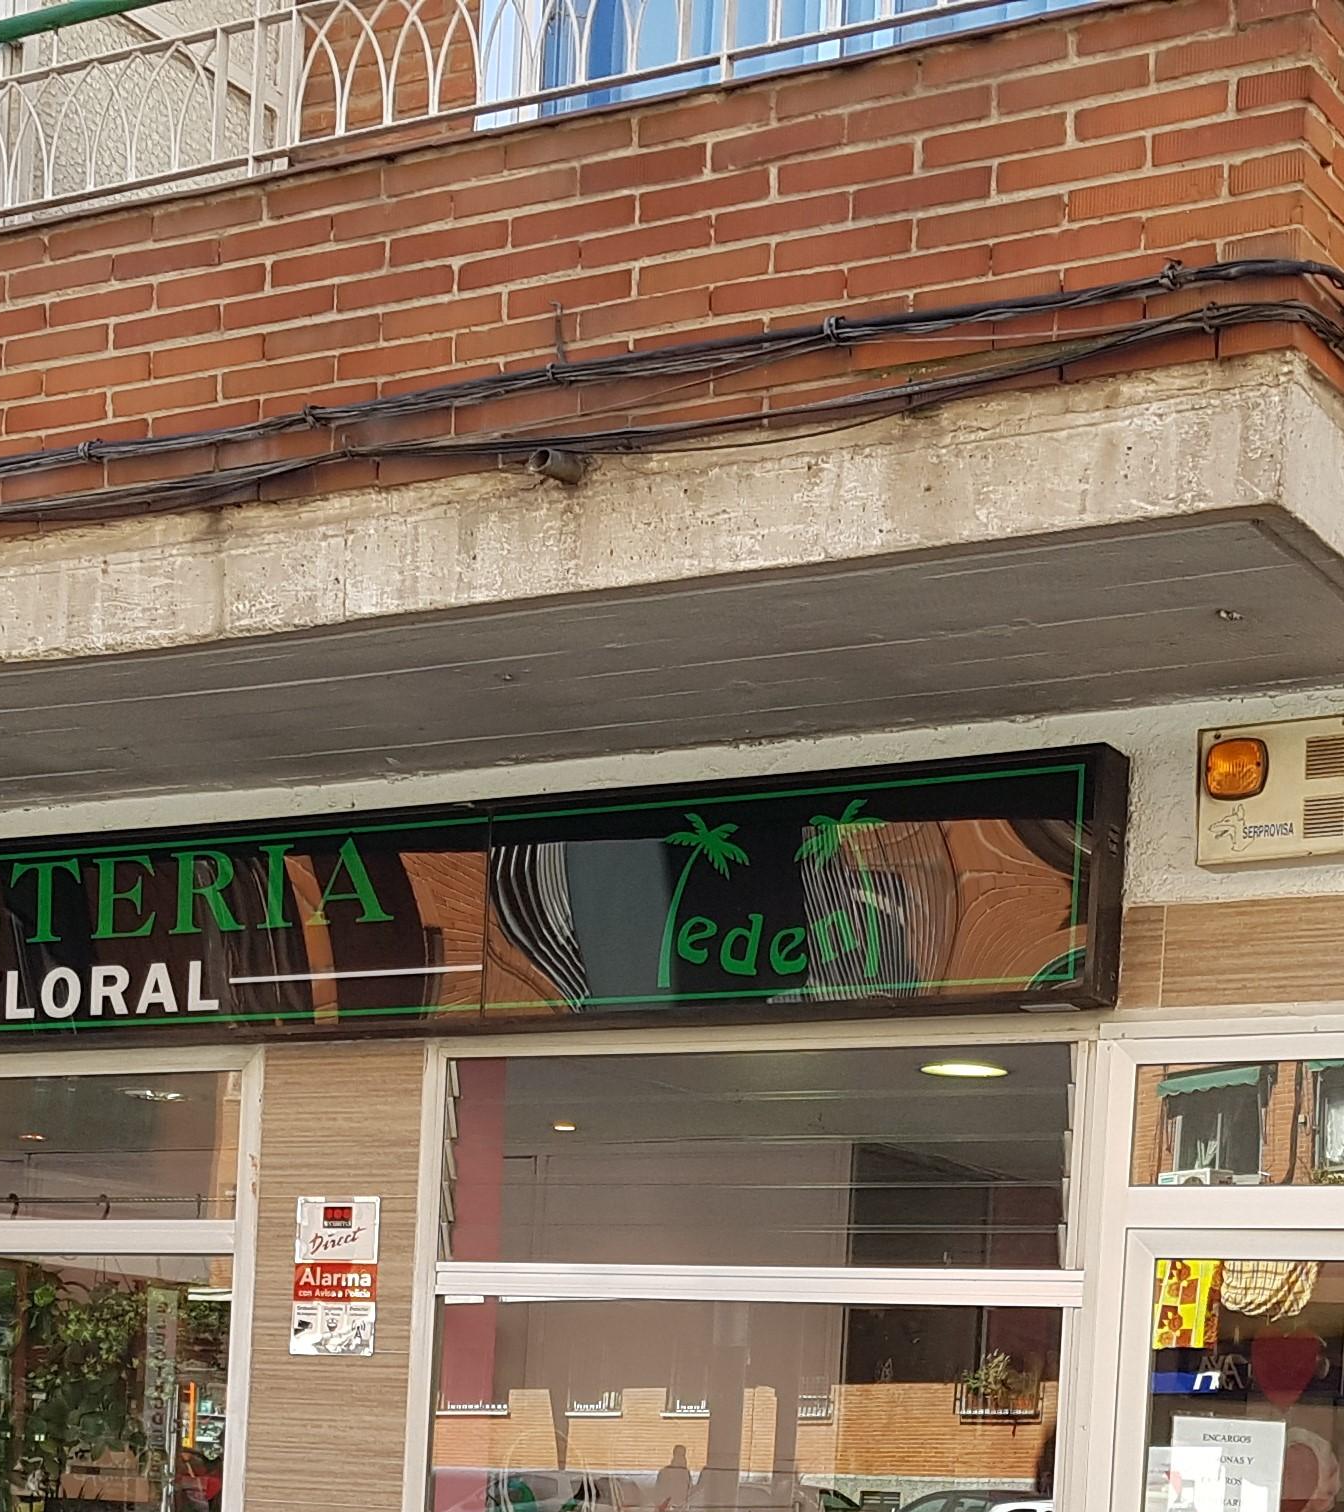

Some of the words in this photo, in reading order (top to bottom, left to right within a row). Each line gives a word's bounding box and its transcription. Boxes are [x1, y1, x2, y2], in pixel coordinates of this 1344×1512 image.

[1242, 822, 1294, 840] SERPROVISA
[676, 909, 860, 976] eden
[309, 1227, 367, 1256] Direct
[299, 1267, 372, 1287] Alarma
[1202, 1433, 1252, 1444] ENCARGOS
